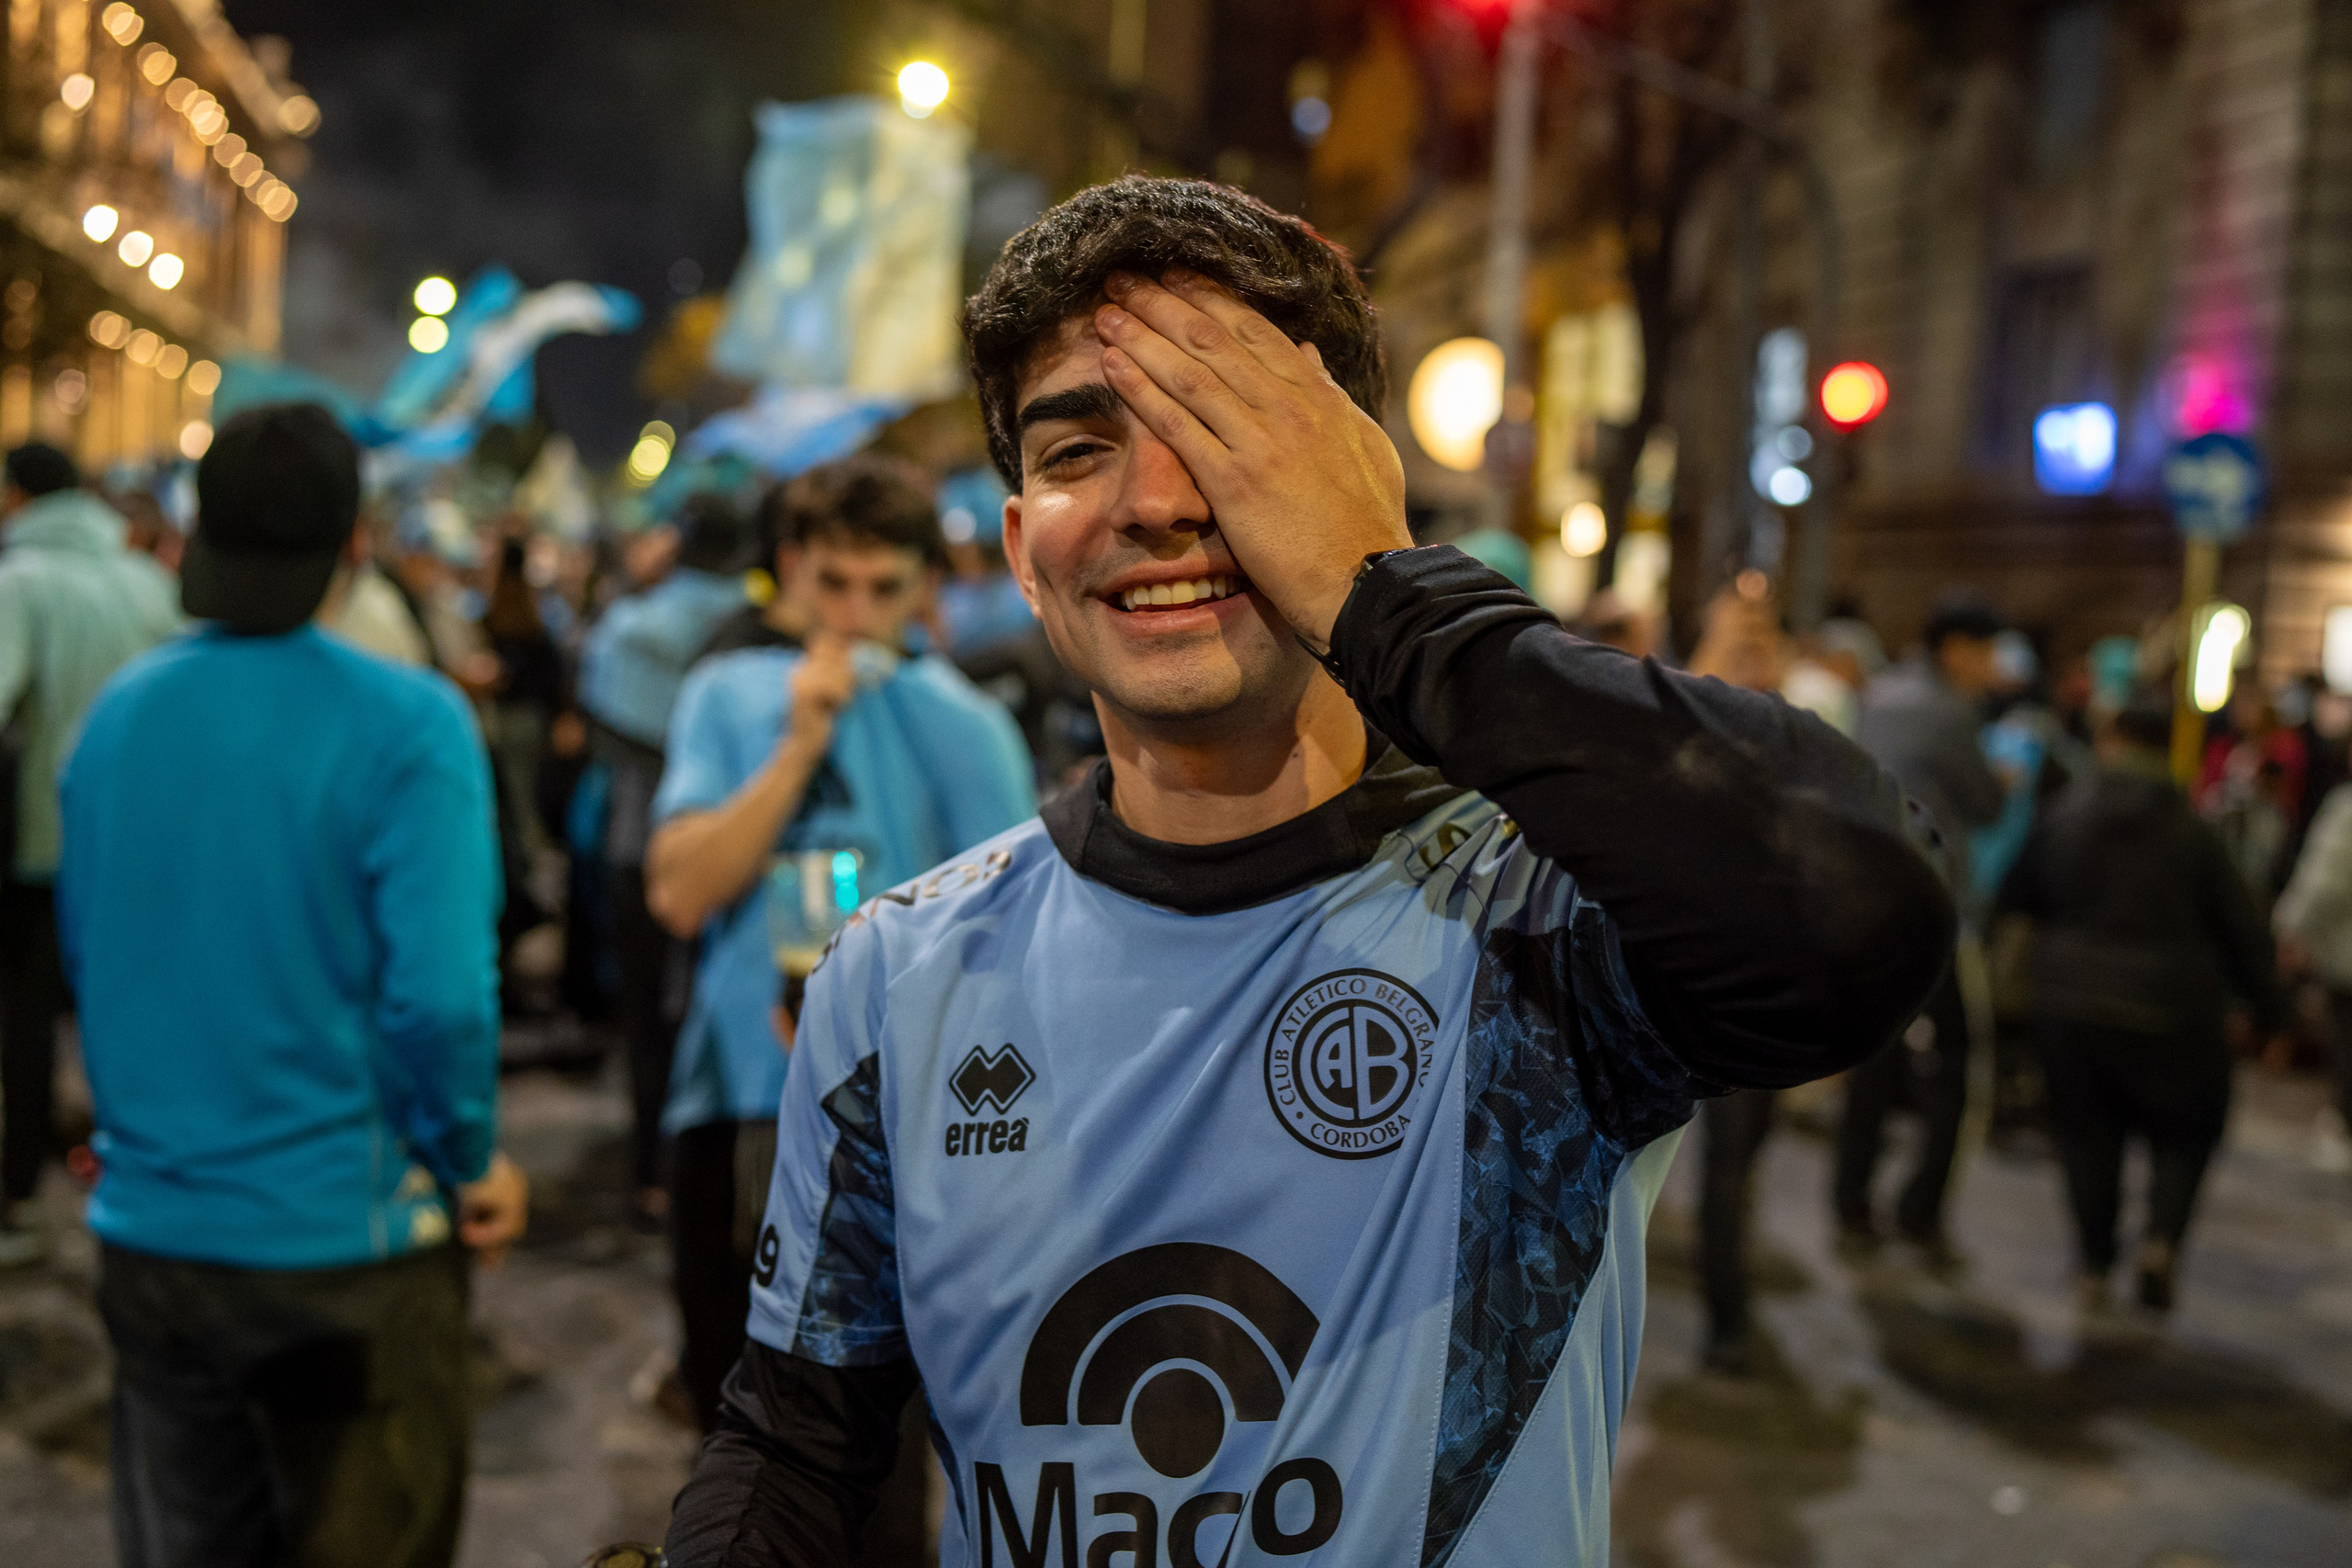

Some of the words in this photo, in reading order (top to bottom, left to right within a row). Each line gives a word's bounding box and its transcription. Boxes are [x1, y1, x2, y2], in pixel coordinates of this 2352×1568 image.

[1282, 978, 1367, 1042] ATLETICO
[1274, 1049, 1296, 1106] CLUB
[1310, 1114, 1411, 1148] CORDOBA
[974, 1457, 1343, 1568] Maco
